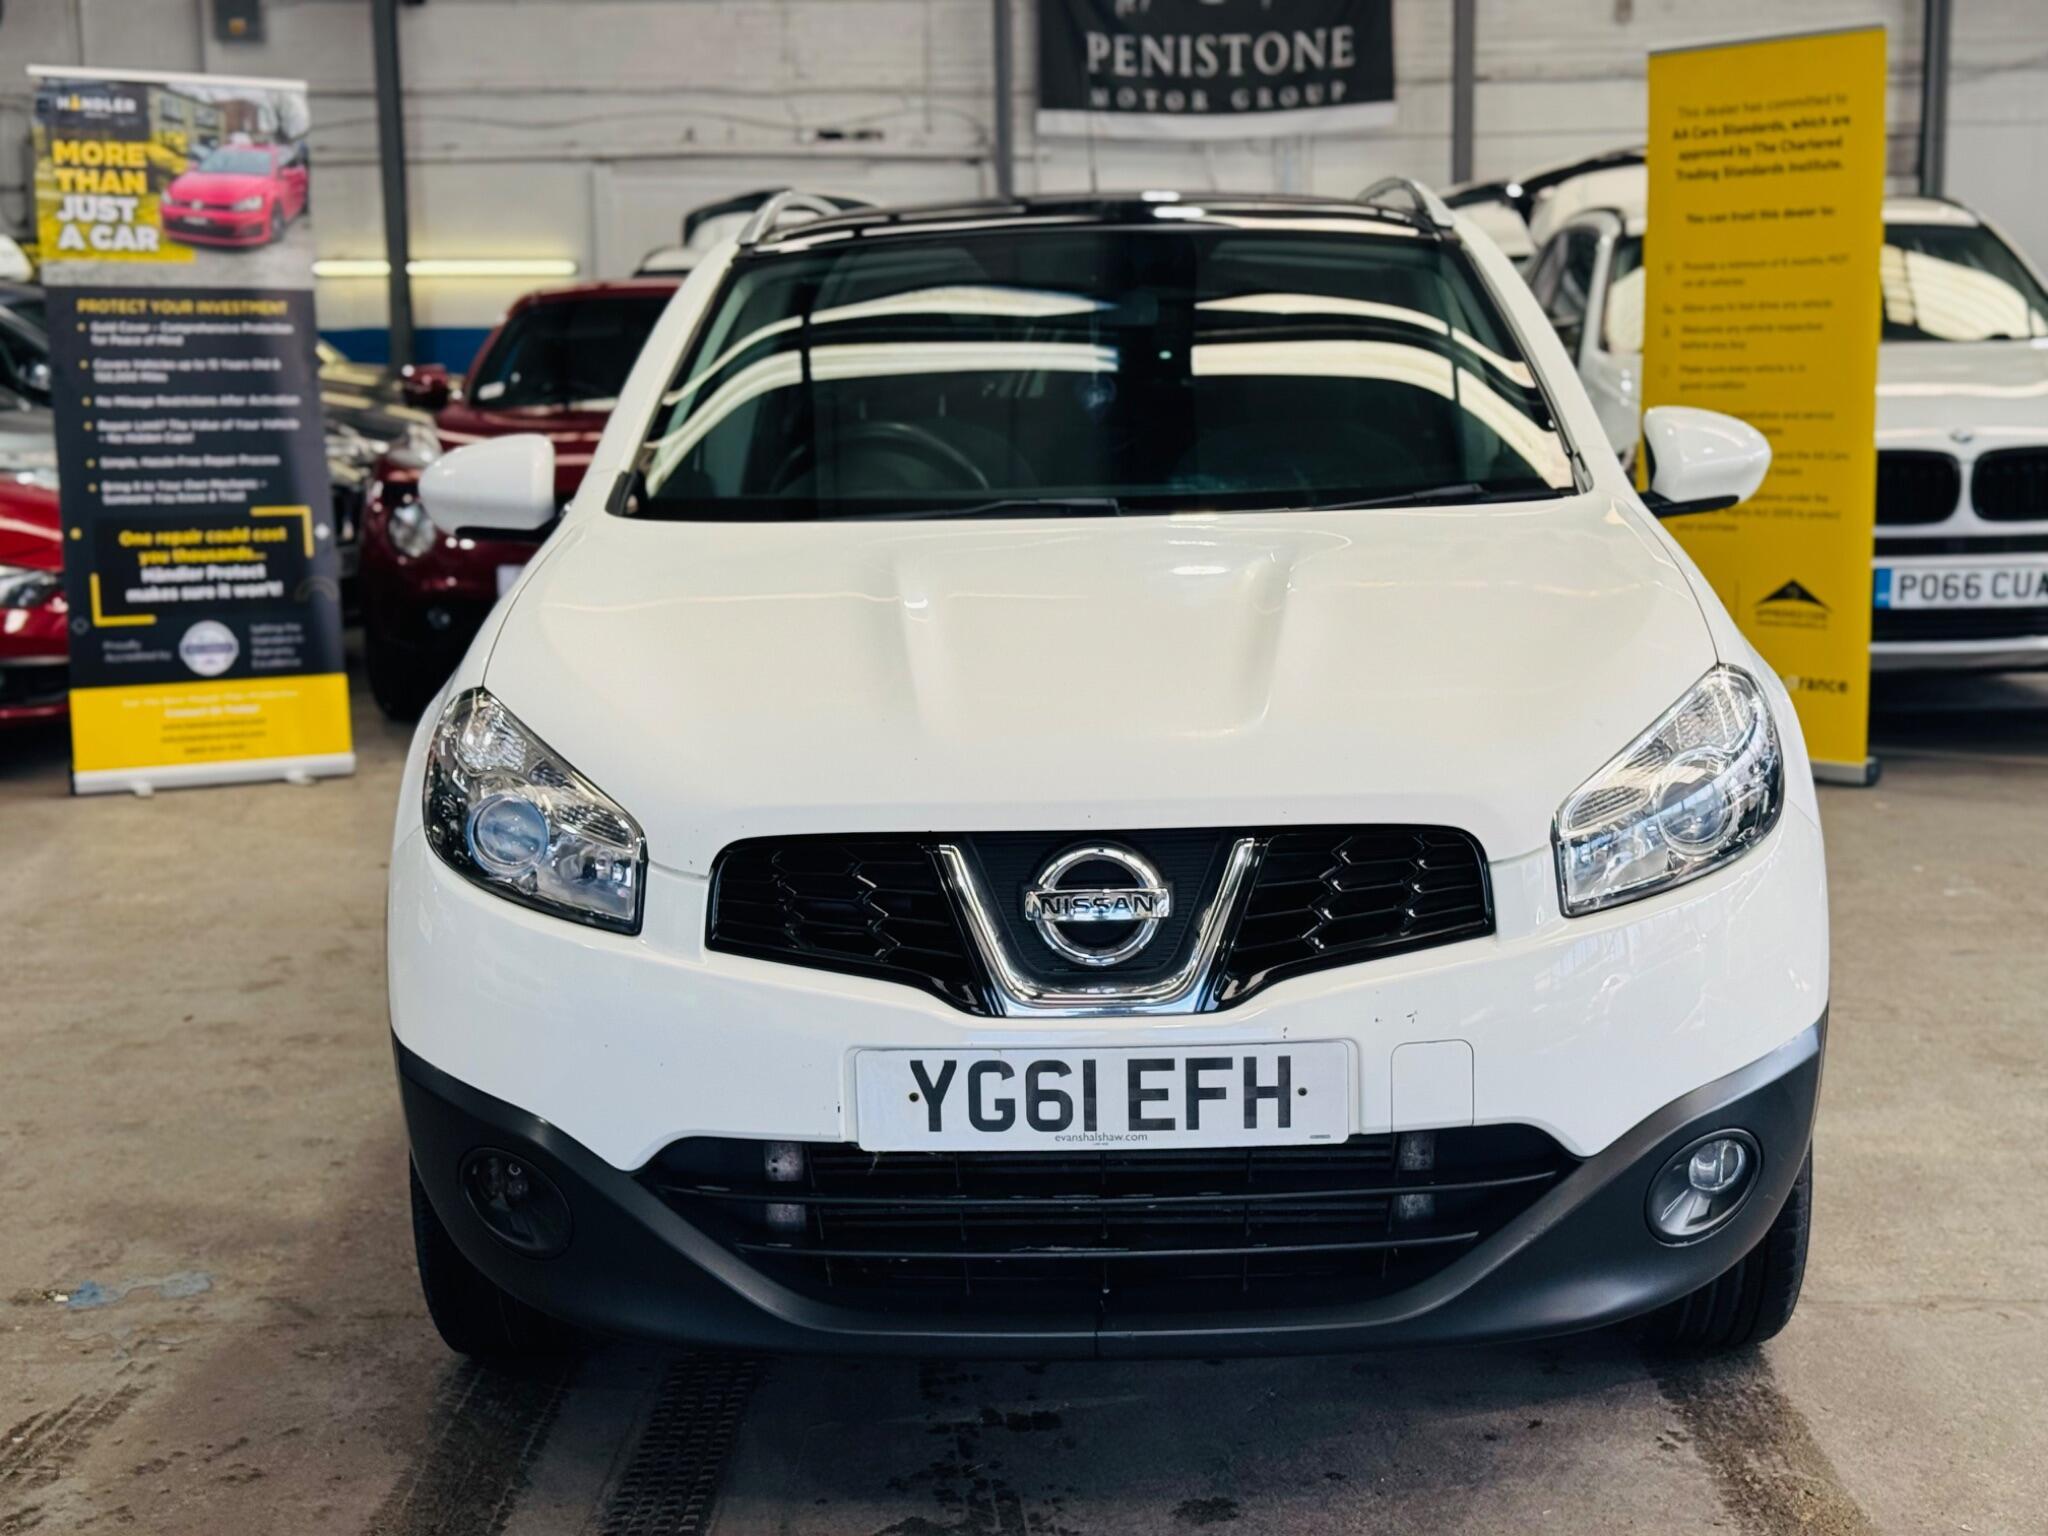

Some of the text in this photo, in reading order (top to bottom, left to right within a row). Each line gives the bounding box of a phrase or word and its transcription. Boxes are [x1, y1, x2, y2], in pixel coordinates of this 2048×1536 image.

[1085, 26, 1355, 78] PENISTONE
[1089, 79, 1347, 112] MOTOR GROUP
[52, 139, 147, 167] MORE
[53, 168, 147, 195] THAN
[56, 196, 139, 223] JUST
[57, 223, 160, 252] A CAR
[77, 297, 288, 317] PROTECT YOUR INVESTMENT
[118, 526, 287, 547] One repair could cost
[138, 549, 171, 567] you
[205, 563, 267, 581] Protect
[125, 586, 179, 603] makes
[180, 585, 217, 601] sure
[217, 582, 232, 600] it
[1041, 895, 1154, 915] NISSAN
[909, 1055, 1292, 1134] YG61 EFH
[1054, 1132, 1148, 1143] evanshalshaw.com
